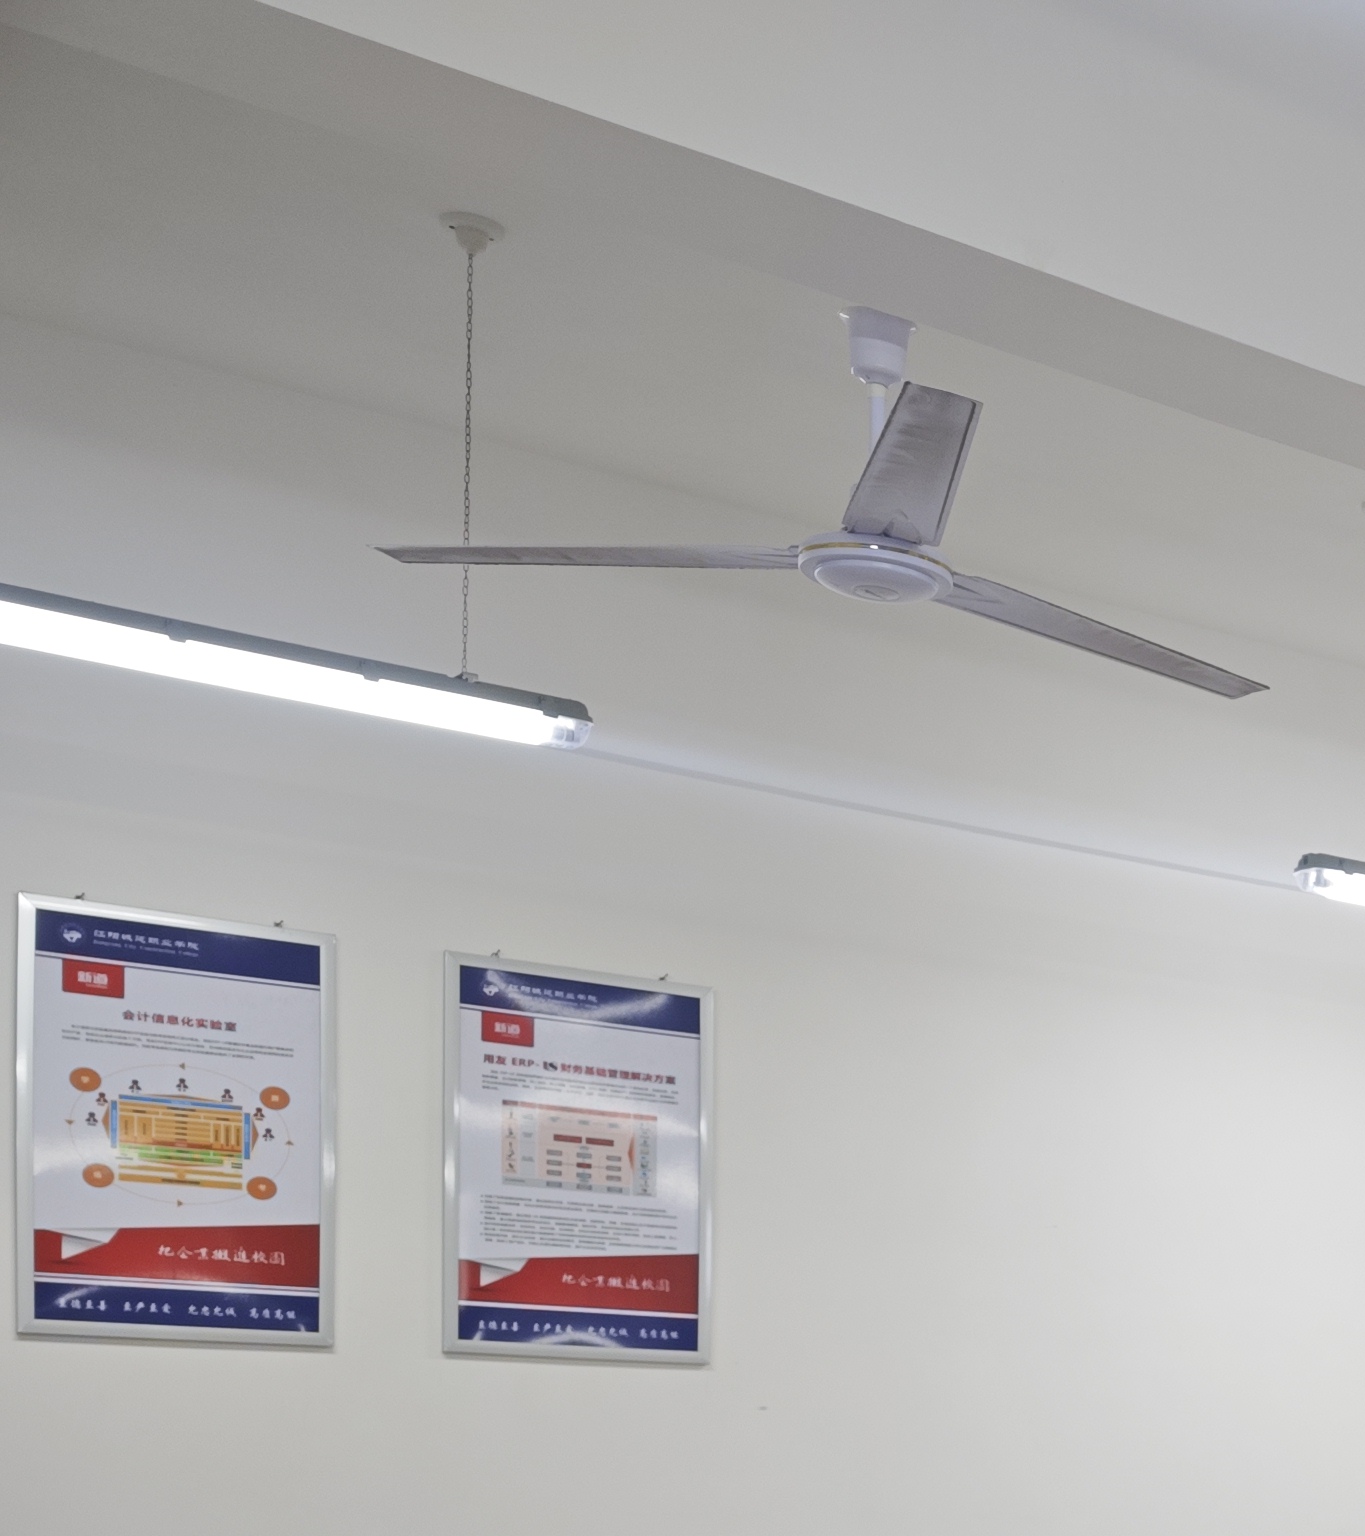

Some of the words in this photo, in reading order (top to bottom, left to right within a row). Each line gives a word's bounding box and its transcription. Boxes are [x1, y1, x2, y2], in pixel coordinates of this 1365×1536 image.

[122, 1009, 238, 1033] 会计信息化实验室
